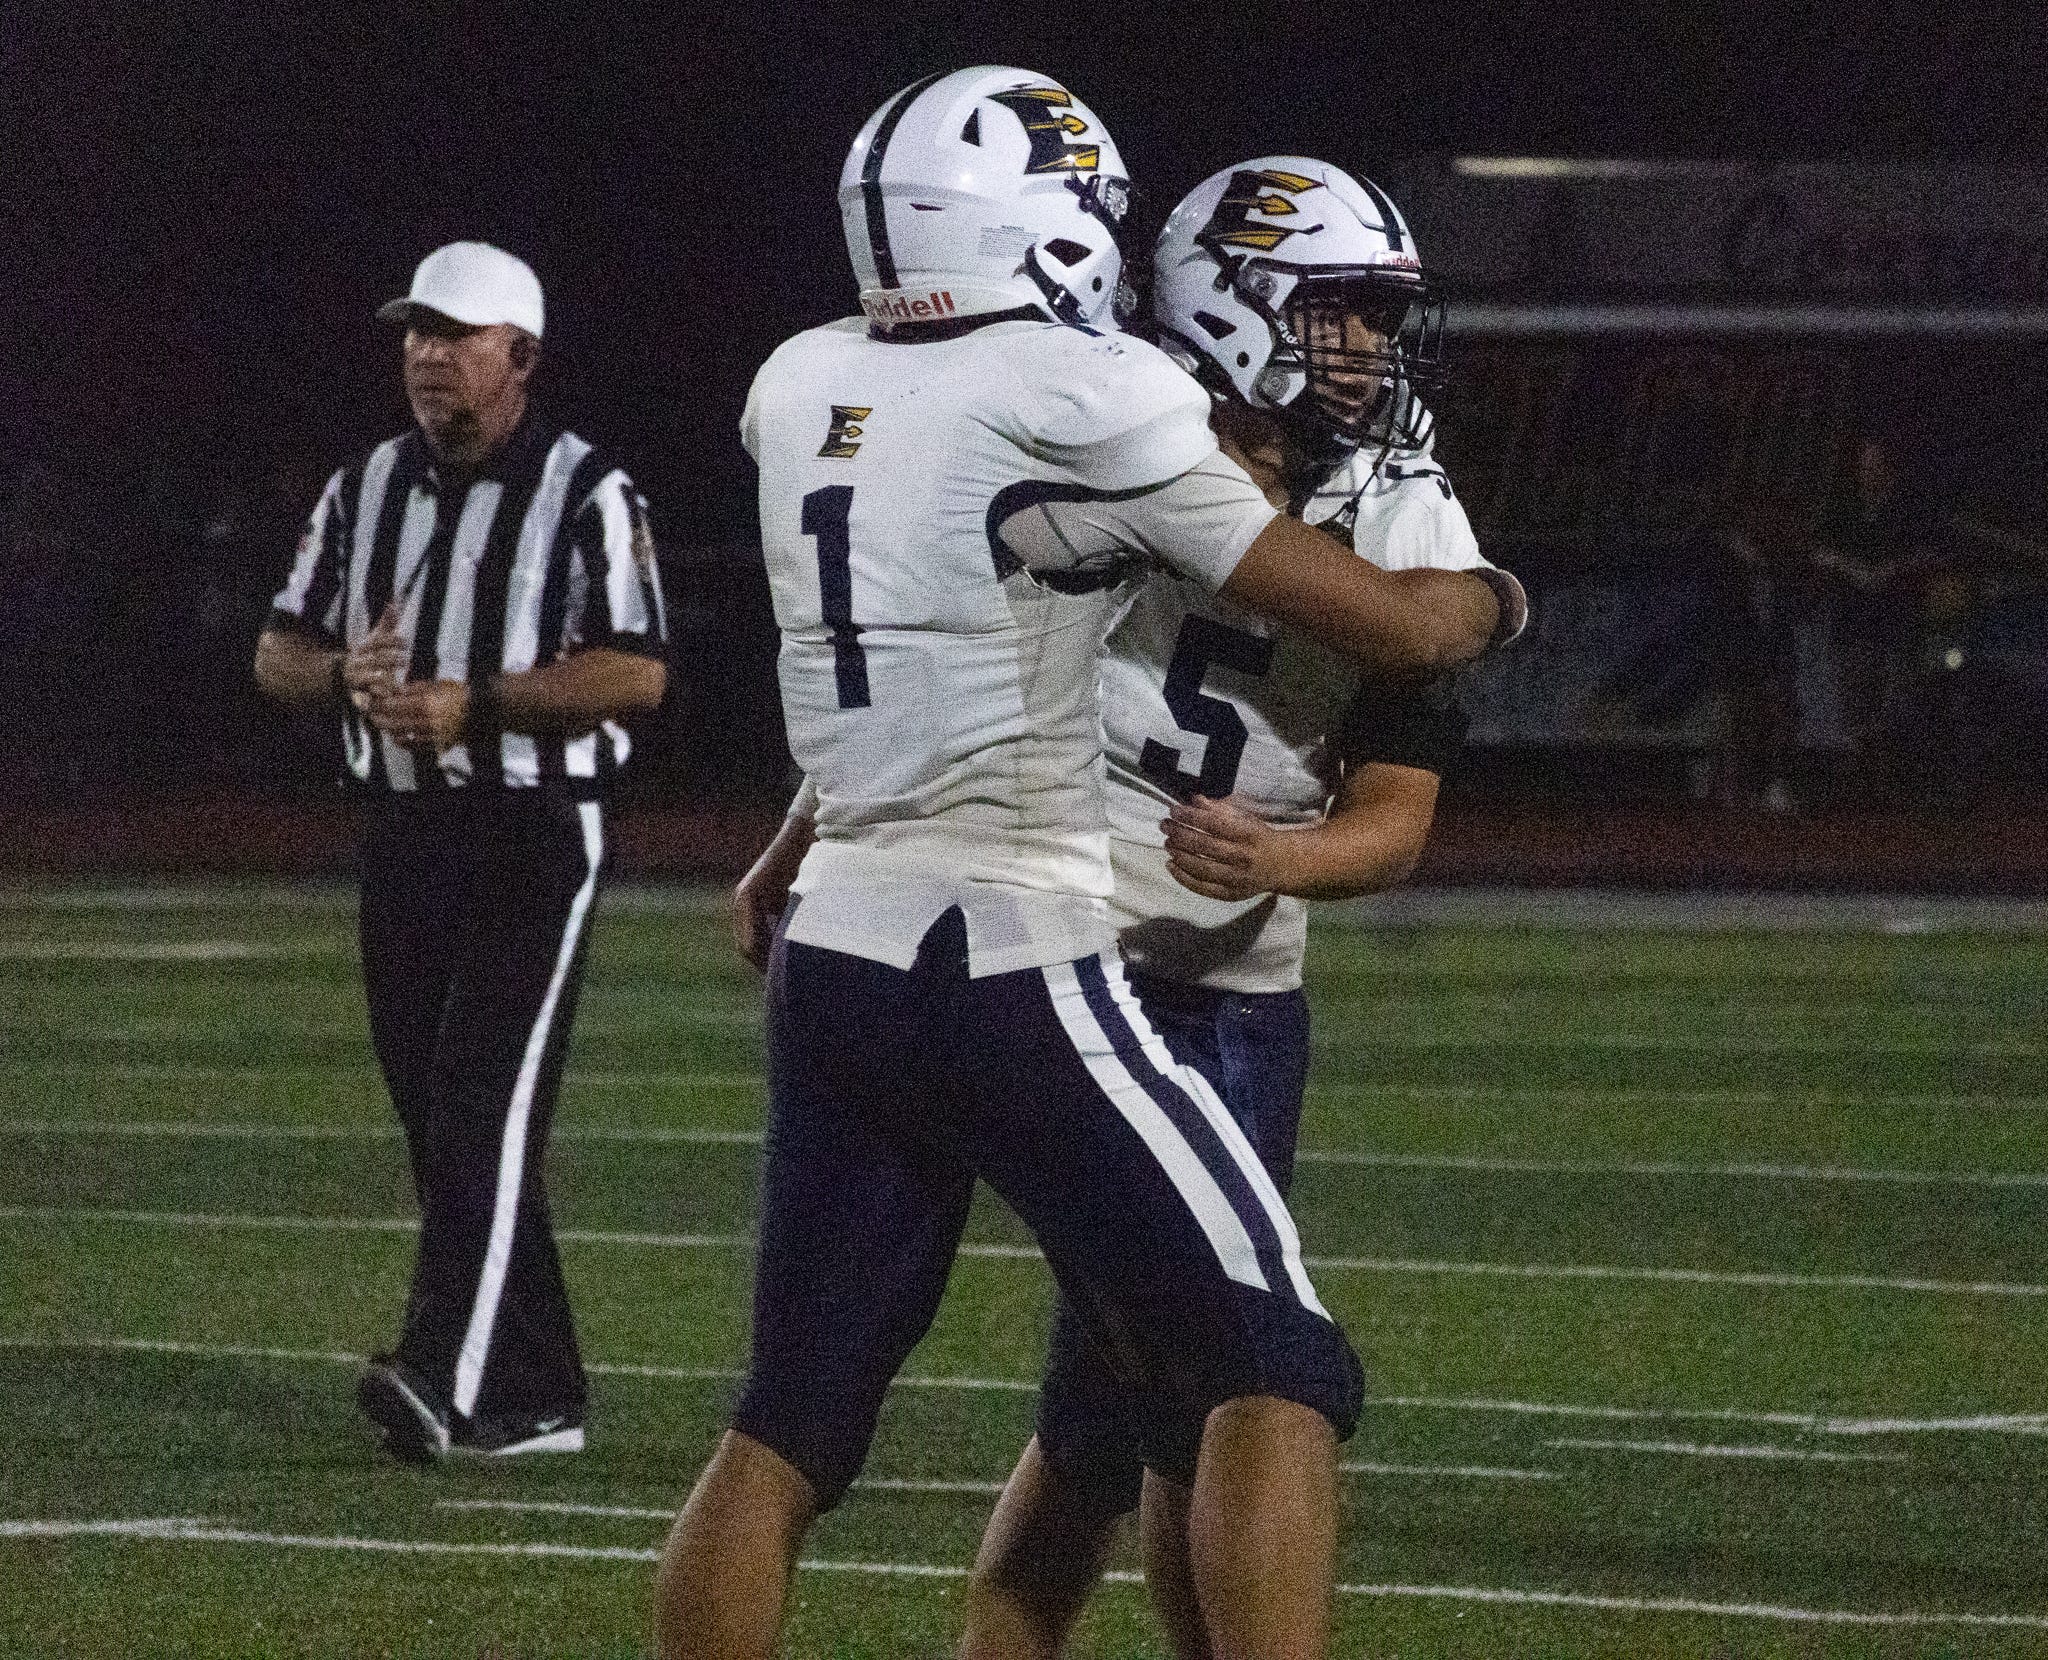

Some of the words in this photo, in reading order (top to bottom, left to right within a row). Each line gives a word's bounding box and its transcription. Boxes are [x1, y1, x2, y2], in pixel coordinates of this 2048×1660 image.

[816, 404, 873, 459] E
[801, 485, 872, 708] 1
[1138, 612, 1276, 800] 5
